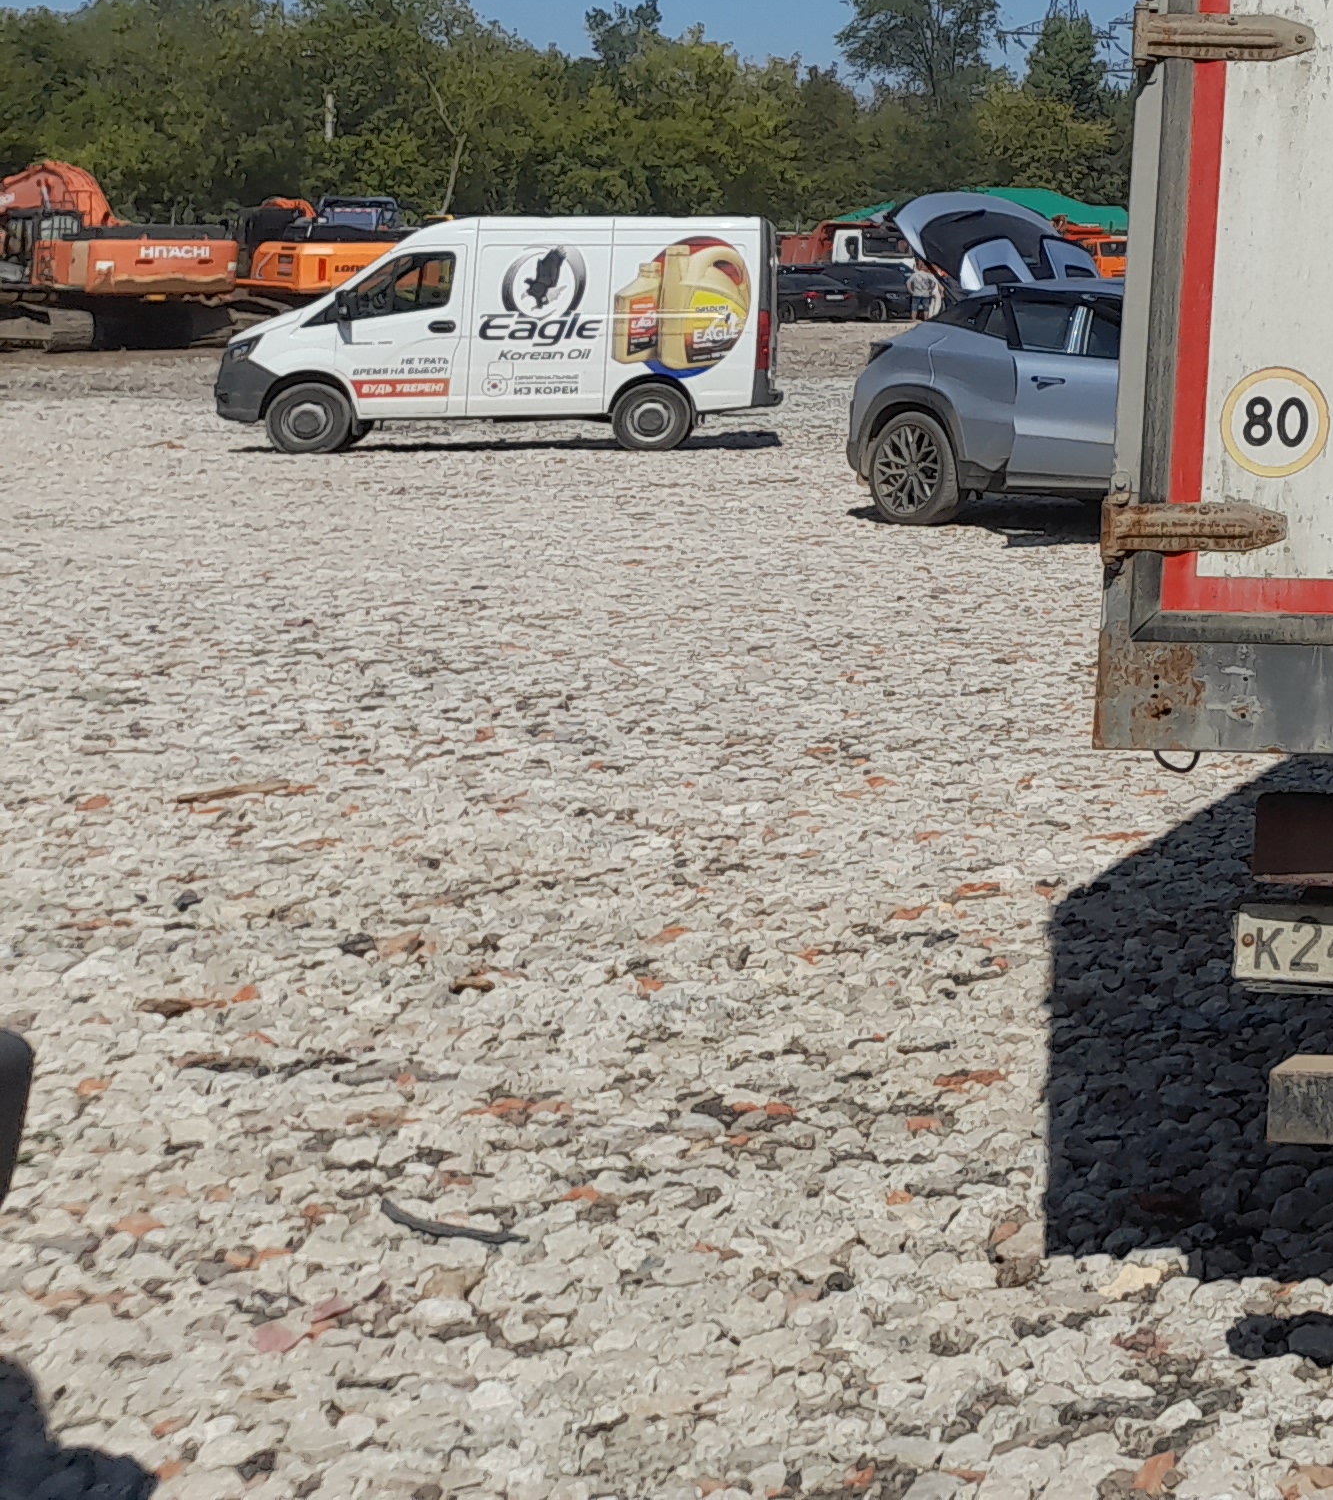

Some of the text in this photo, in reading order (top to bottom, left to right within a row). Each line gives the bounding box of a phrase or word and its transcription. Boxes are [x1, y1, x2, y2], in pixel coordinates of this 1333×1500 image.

[140, 245, 210, 259] HITACHI
[478, 312, 604, 348] Eagle
[693, 327, 738, 343] EAGLE
[400, 356, 449, 366] НЕ ТРАТЬ
[498, 348, 592, 361] Korean Oil
[352, 367, 389, 376] ВРЕМЯ
[390, 367, 405, 375] НА
[361, 382, 445, 395] БУДЬ УВЕРЕН!
[513, 385, 579, 396] ИЗ КОРЕИ
[1242, 395, 1309, 448] 80
